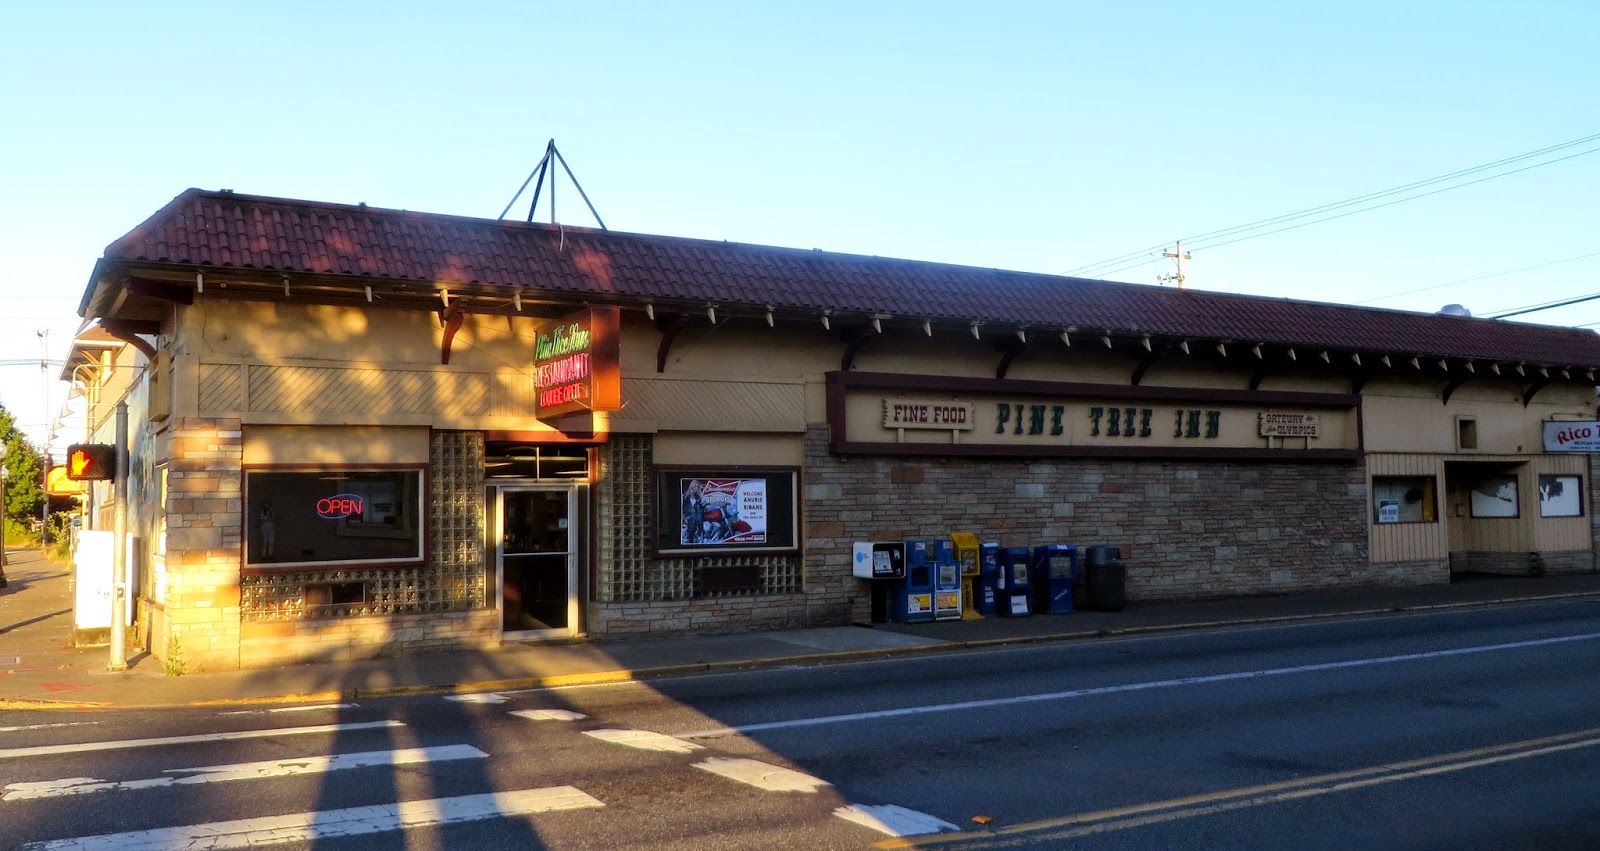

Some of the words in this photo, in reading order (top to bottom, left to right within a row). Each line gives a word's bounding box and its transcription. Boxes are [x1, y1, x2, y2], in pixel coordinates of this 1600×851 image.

[535, 353, 589, 388] RESTAURANT
[893, 404, 928, 423] FINE
[933, 406, 966, 424] FOOD
[996, 403, 1064, 435] PINE
[1088, 406, 1153, 437] TREE
[1173, 409, 1221, 439] INN
[1266, 413, 1304, 423] GATEWAY
[1277, 425, 1316, 435] OLYMPICS
[1557, 427, 1592, 445] Rico
[316, 498, 362, 515] OPEN
[1379, 508, 1388, 516] FOR
[1388, 508, 1398, 516] RENT
